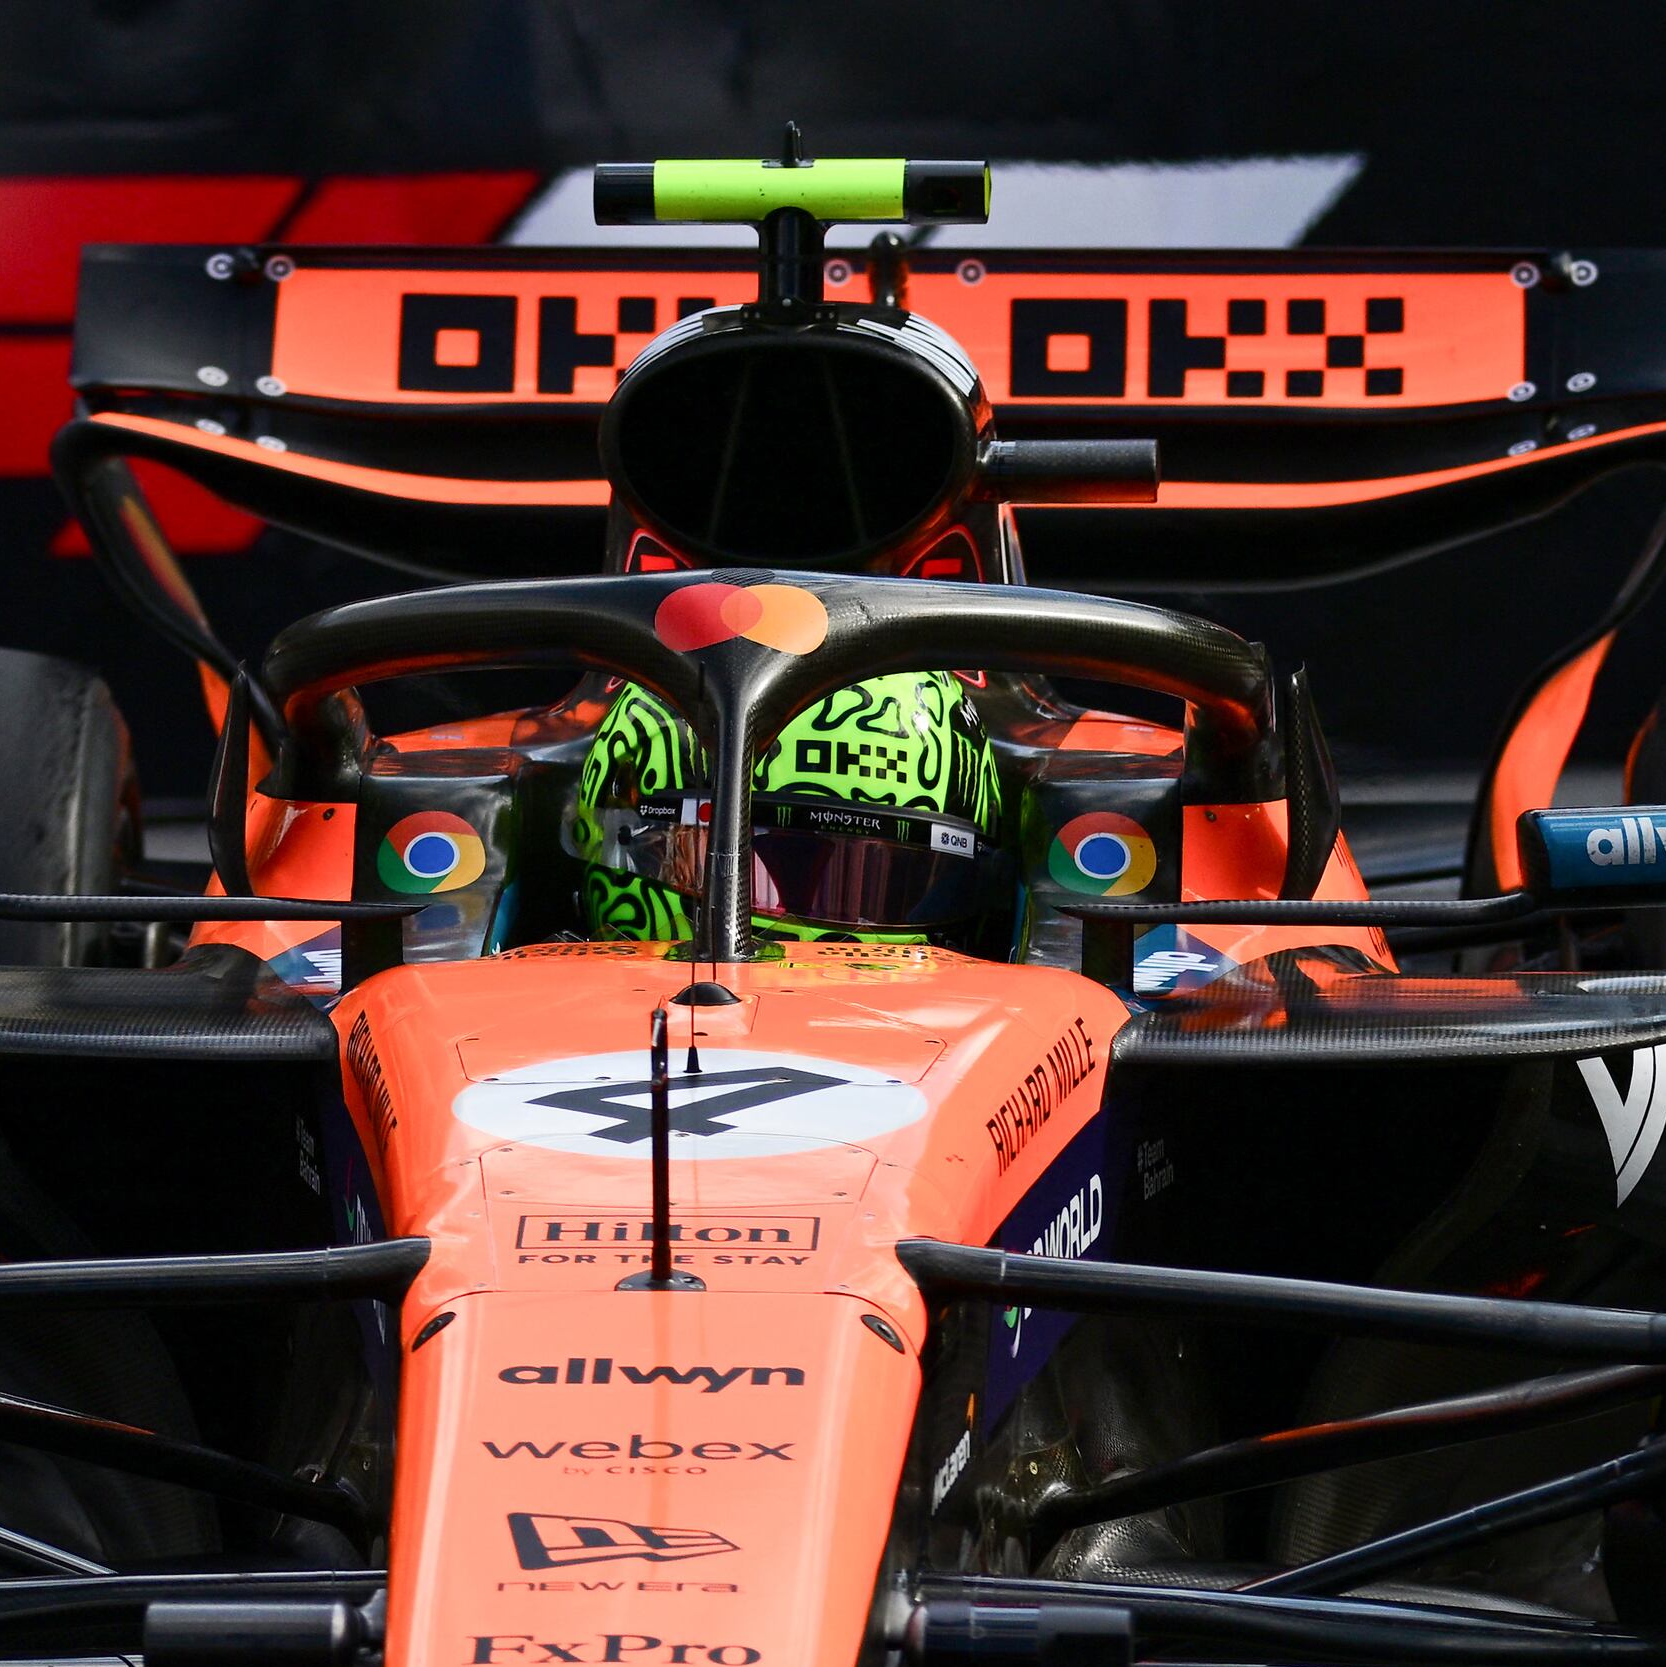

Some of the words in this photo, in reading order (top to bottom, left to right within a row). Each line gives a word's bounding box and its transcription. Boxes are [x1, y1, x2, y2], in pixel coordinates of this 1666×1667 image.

[399, 293, 716, 394] OK
[1010, 298, 1404, 398] OKX
[795, 740, 908, 784] OKX
[648, 806, 676, 816] Dropbox
[809, 810, 881, 830] MONSTER
[950, 835, 968, 849] QNB
[523, 1066, 853, 1144] 4
[985, 1064, 1051, 1177] RICHARD
[1046, 1017, 1096, 1109] MILLE
[1143, 1157, 1174, 1201] Bahrain
[541, 1221, 793, 1243] Hilton
[1044, 1173, 1103, 1259] WORLD
[517, 1254, 597, 1265] FOR
[712, 1255, 811, 1267] STAY
[498, 1358, 805, 1393] allwyn
[481, 1434, 796, 1461] webex
[606, 1465, 708, 1475] CISCO
[462, 1634, 762, 1667] FxPro
